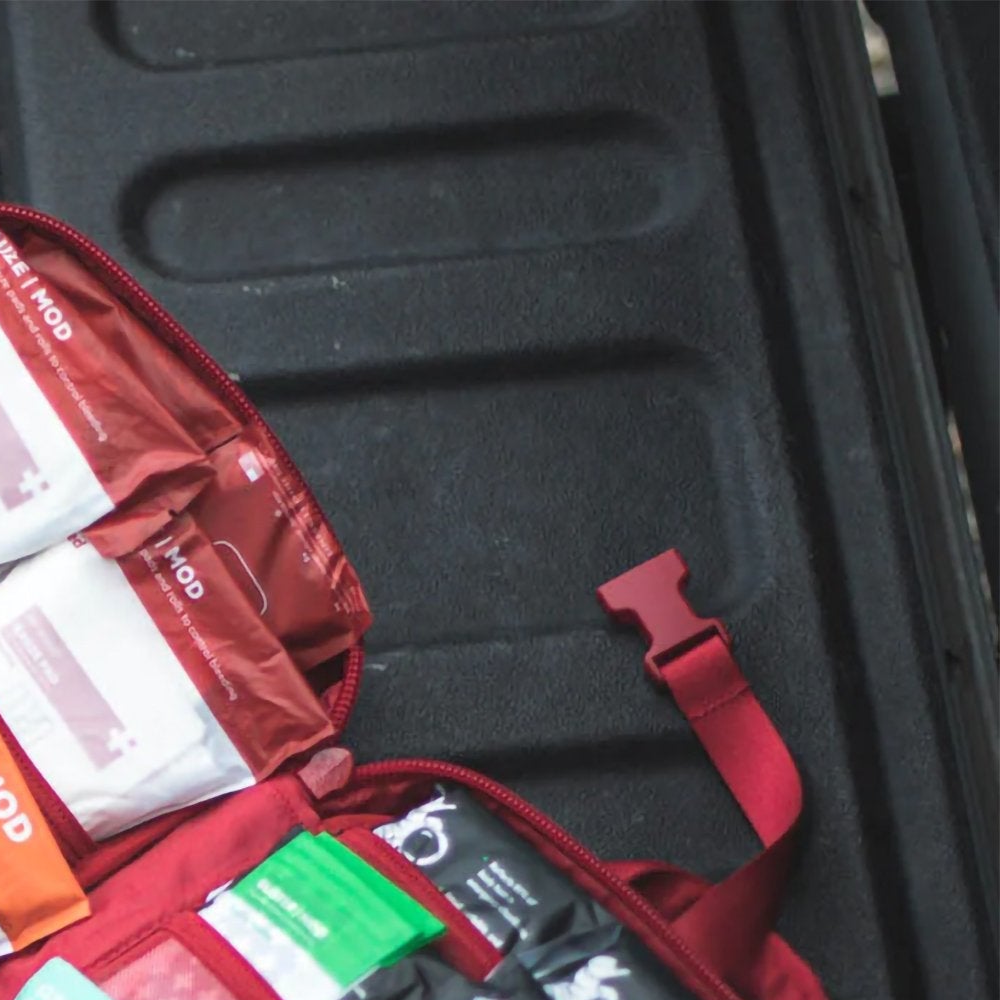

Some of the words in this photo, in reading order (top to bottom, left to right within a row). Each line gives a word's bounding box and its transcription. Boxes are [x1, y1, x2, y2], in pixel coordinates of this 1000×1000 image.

[22, 314, 40, 333] and
[49, 354, 59, 368] to
[30, 288, 72, 341] MOD
[165, 545, 204, 599] MOD
[155, 573, 172, 592] and
[180, 613, 191, 626] to
